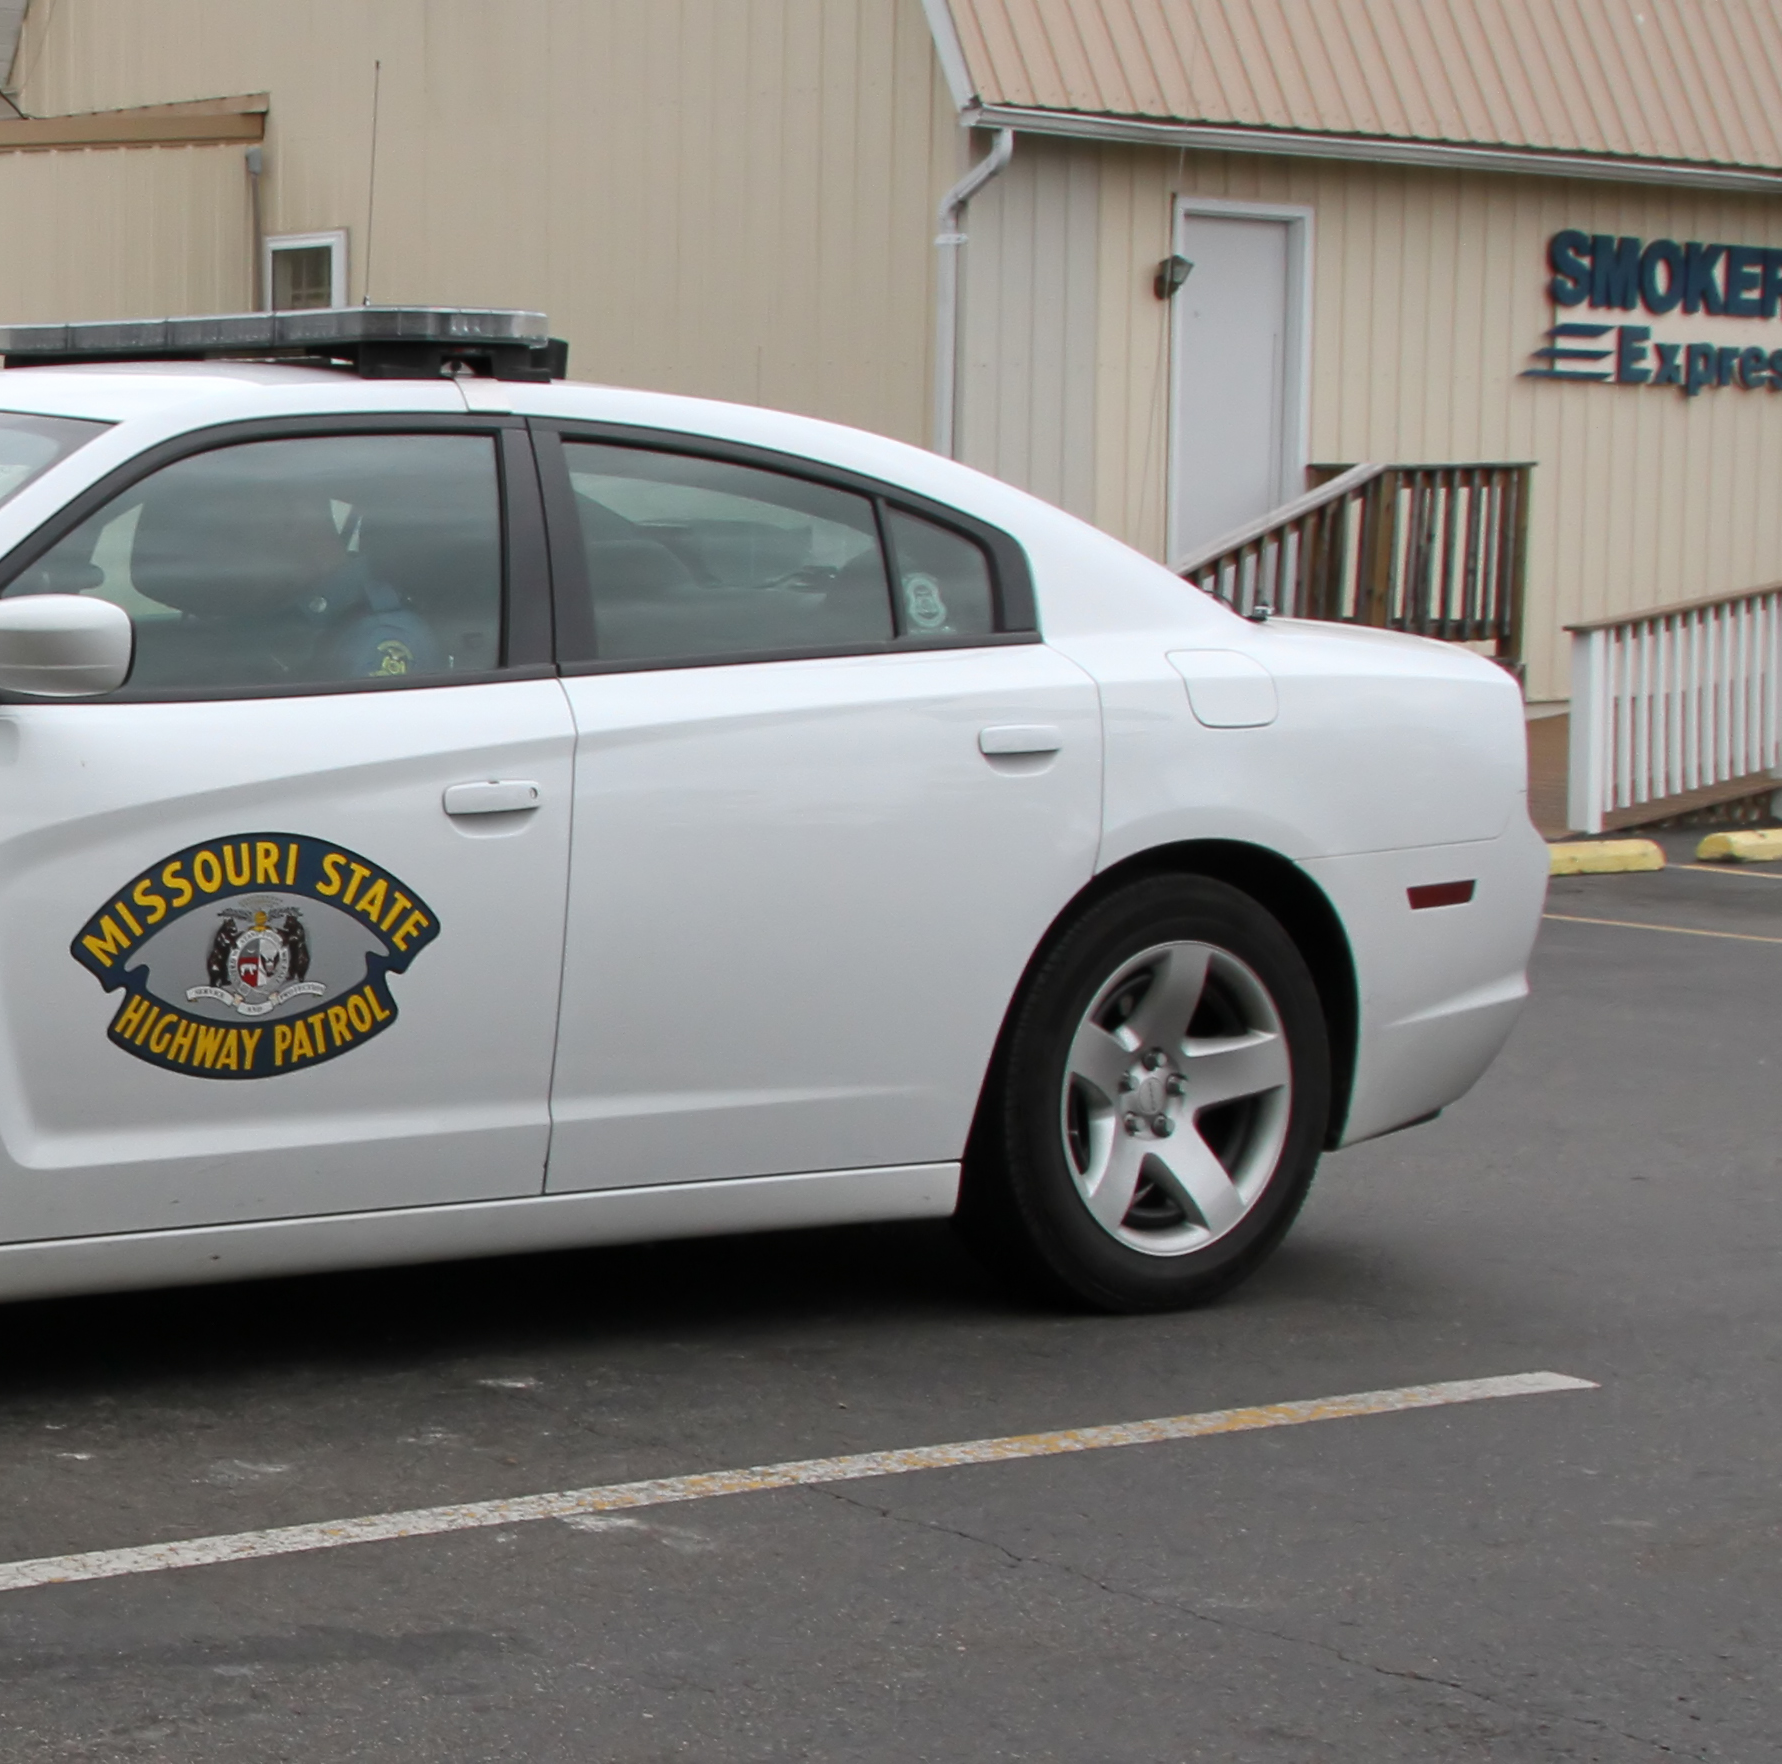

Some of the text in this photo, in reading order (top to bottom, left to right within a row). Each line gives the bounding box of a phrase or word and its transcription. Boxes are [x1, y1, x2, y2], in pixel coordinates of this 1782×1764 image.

[82, 841, 299, 969] MISSOURI
[315, 852, 430, 952] STATE
[114, 985, 393, 1071] HIGHWAY PATROL
